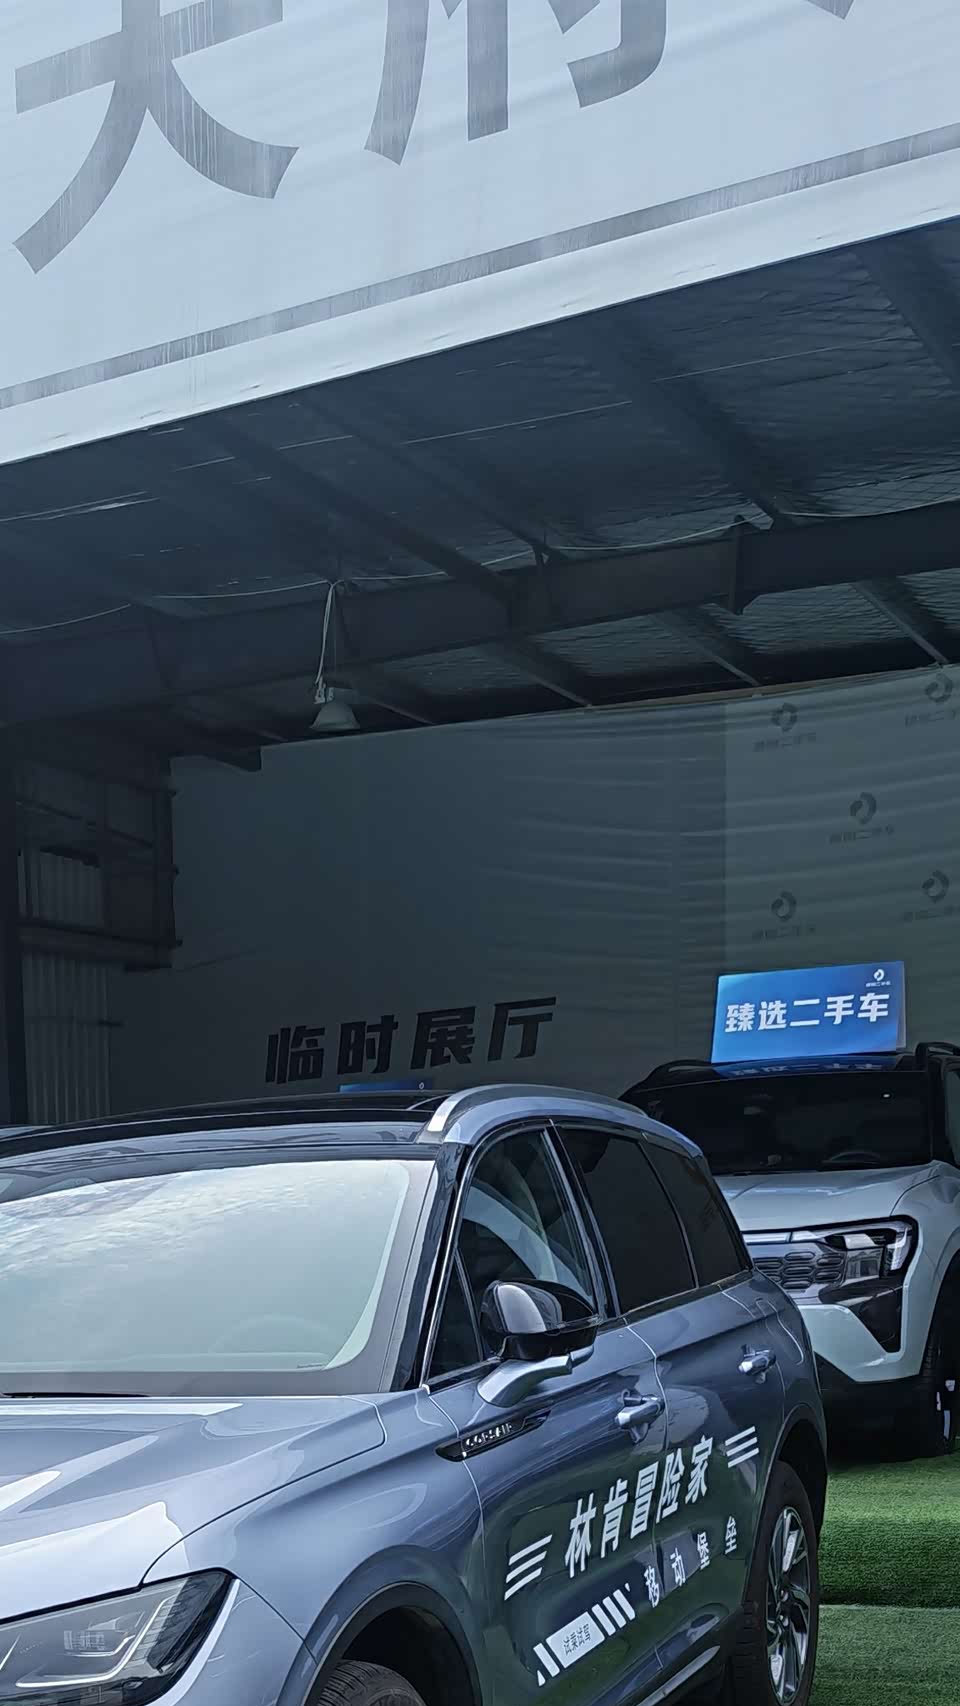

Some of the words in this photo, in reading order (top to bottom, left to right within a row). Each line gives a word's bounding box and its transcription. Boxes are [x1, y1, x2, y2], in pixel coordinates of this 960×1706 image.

[265, 996, 557, 1084] 临时展厅
[724, 992, 890, 1033] 臻选二手车
[564, 1434, 714, 1579] 林肯冒险家
[643, 1515, 738, 1609] 移动堡垒
